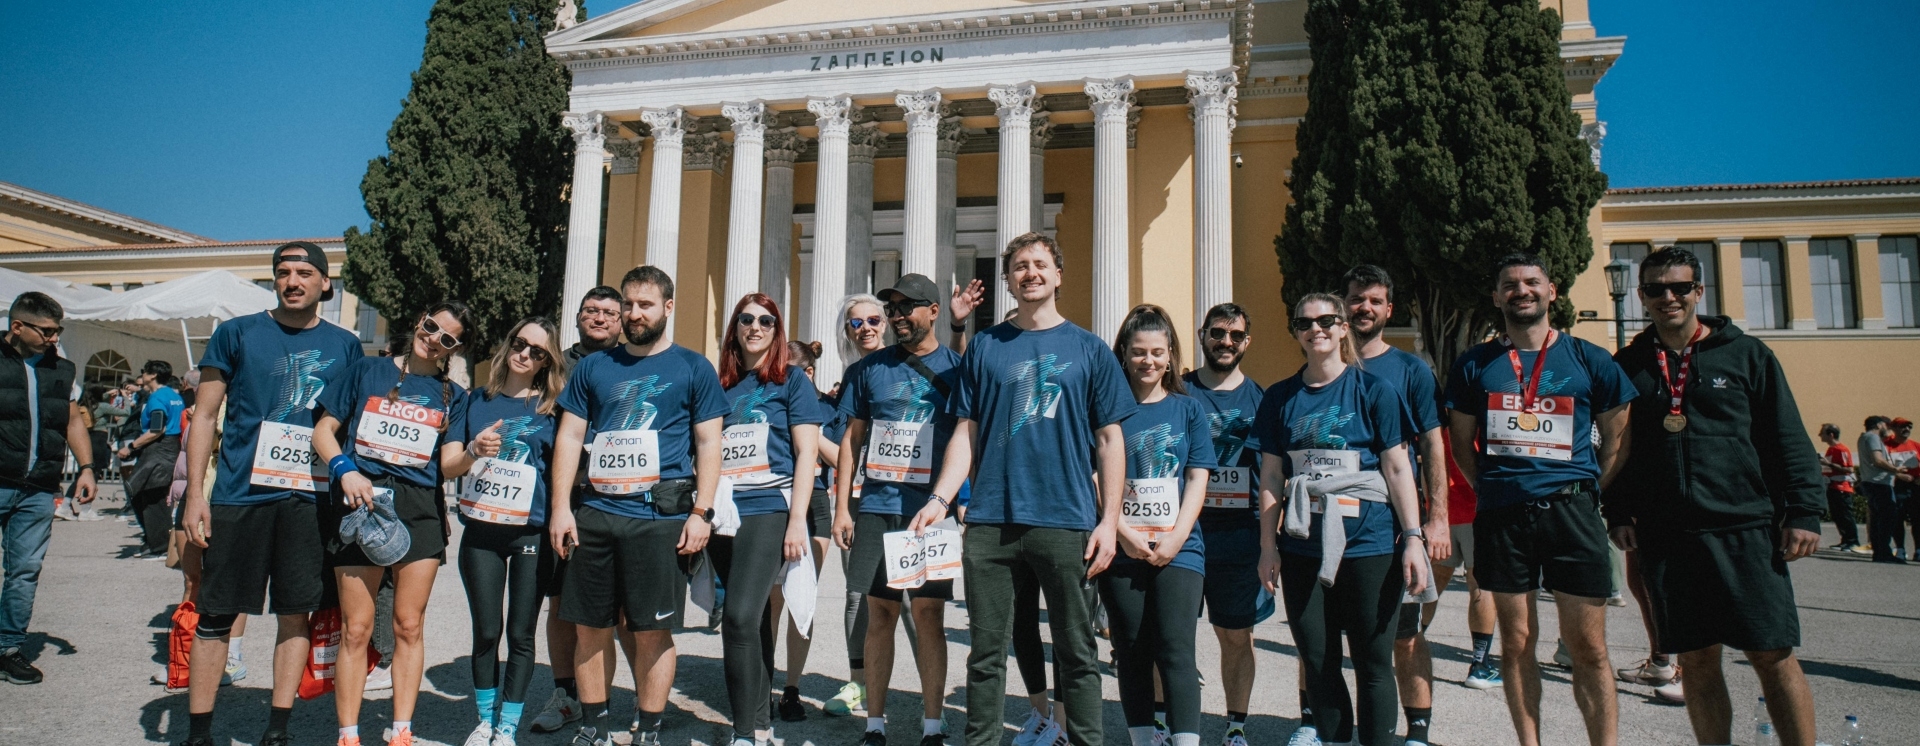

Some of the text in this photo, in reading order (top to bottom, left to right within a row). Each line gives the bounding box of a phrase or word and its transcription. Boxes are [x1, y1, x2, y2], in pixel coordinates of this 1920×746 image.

[810, 47, 944, 72] ΖΑΠΠΕΙΟΝ
[378, 399, 428, 423] ERGO
[377, 420, 420, 442] 3053
[1507, 416, 1553, 434] 50
[270, 445, 320, 467] 62532
[722, 444, 756, 461] 2522
[878, 443, 921, 459] 62555
[599, 453, 647, 469] 62516
[1211, 470, 1239, 484] 519
[474, 479, 522, 500] 62517
[1122, 501, 1171, 517] 62539
[899, 543, 948, 569] 62557
